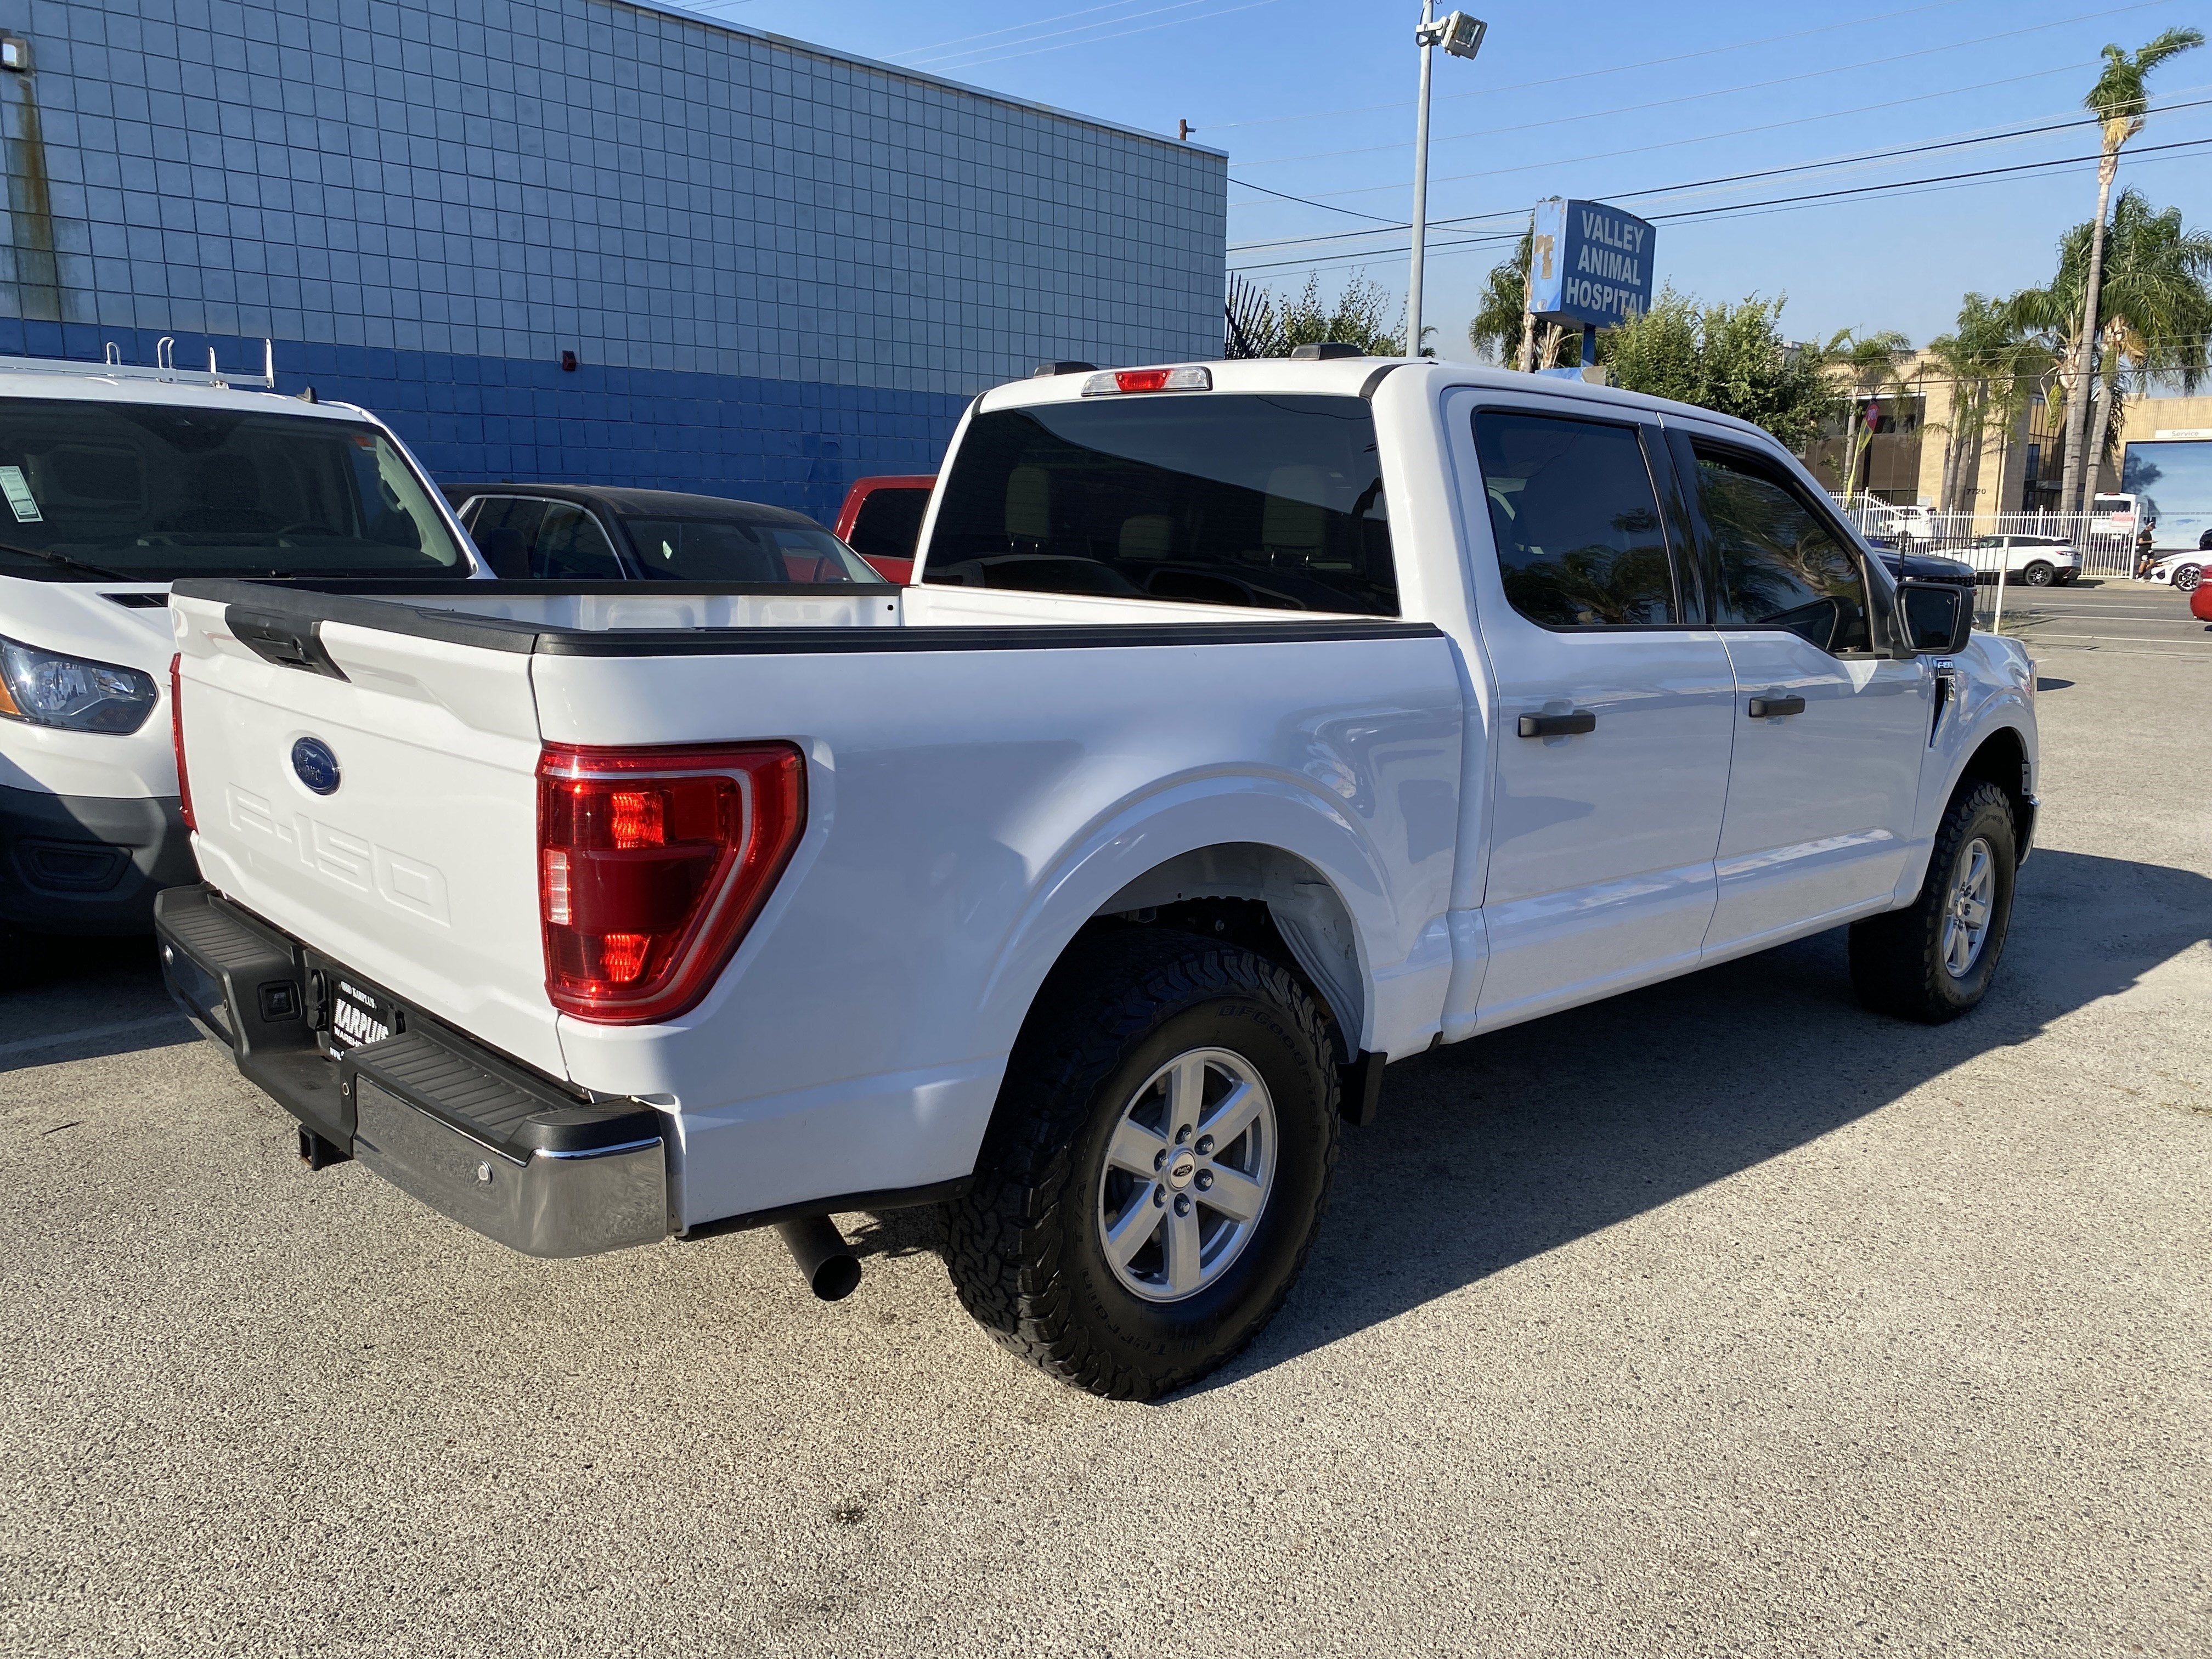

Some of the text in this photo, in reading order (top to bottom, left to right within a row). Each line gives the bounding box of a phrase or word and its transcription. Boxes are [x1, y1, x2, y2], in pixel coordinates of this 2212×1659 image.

[1582, 210, 1644, 253] VALLEY
[1578, 245, 1641, 286] ANIMAL
[226, 782, 451, 928] F-150
[334, 998, 389, 1044] KARPLUS
